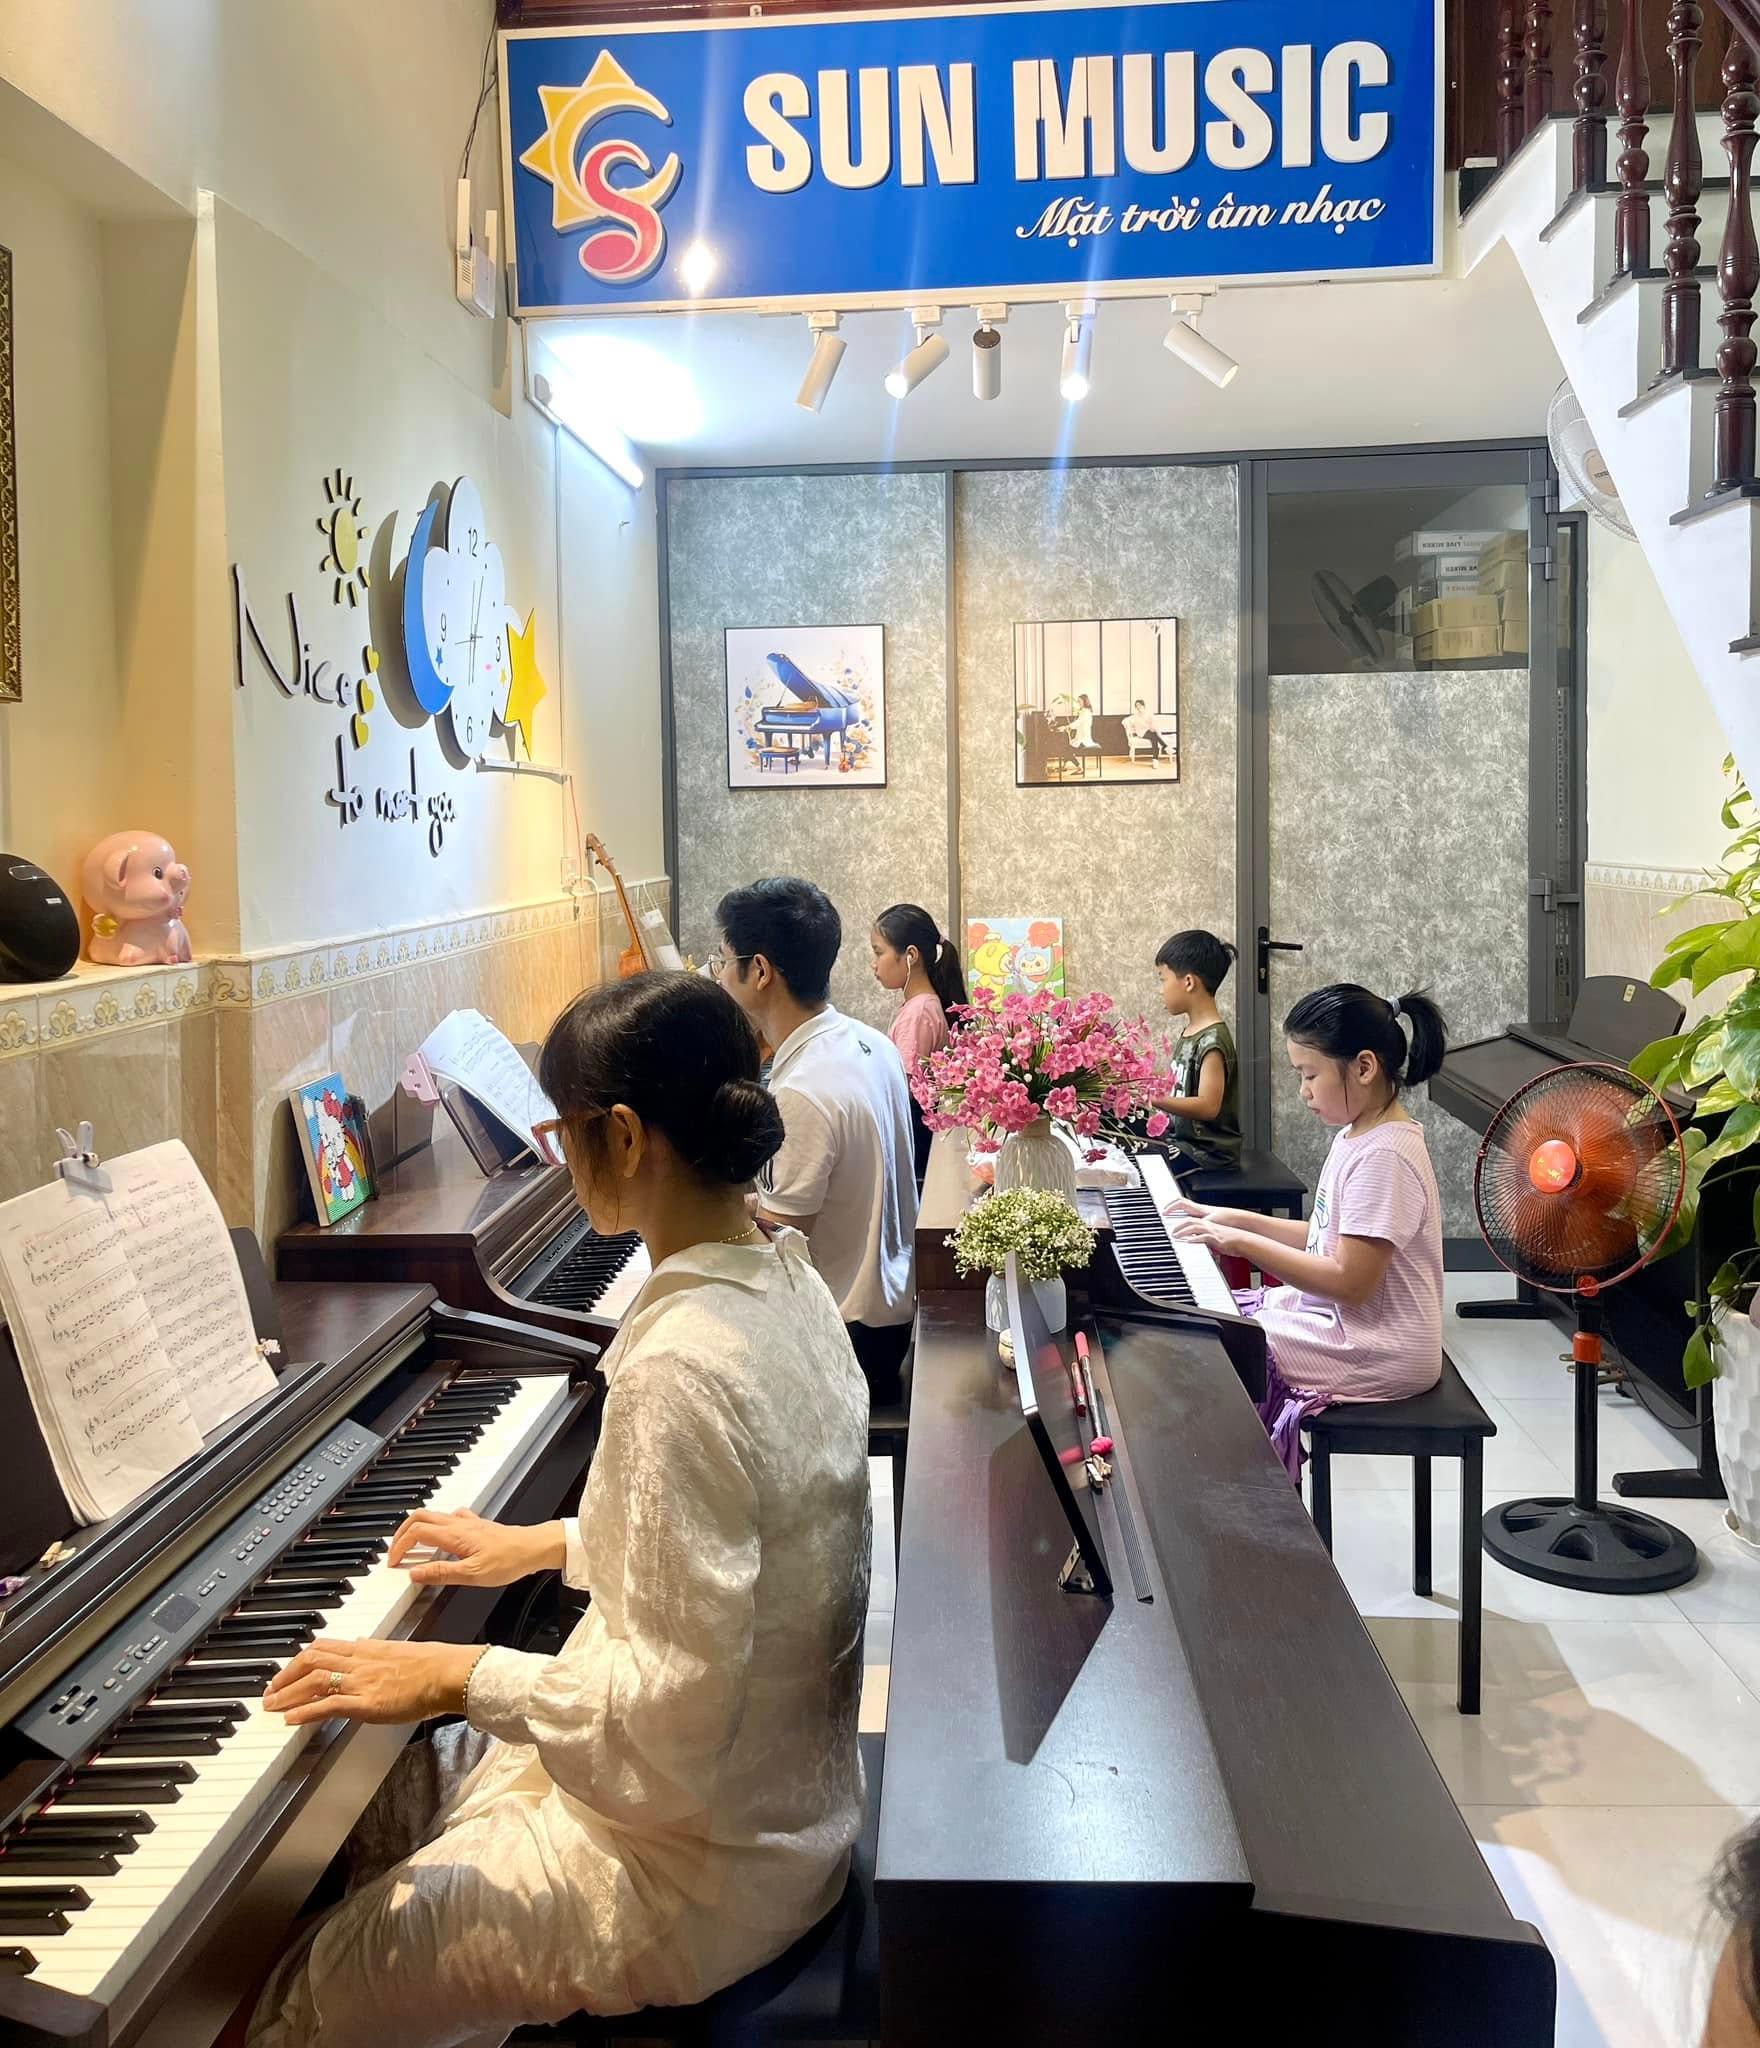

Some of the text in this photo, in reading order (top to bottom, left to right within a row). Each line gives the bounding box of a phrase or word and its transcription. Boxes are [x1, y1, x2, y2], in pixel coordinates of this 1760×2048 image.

[743, 40, 1390, 194] SUN MUSIC
[1015, 183, 1387, 247] Mặt trời âm nhạc
[467, 528, 478, 558] 12
[231, 563, 354, 708] Nice
[440, 611, 448, 642] 9
[494, 635, 502, 663] 3
[465, 716, 473, 744] 6
[327, 734, 365, 828] to
